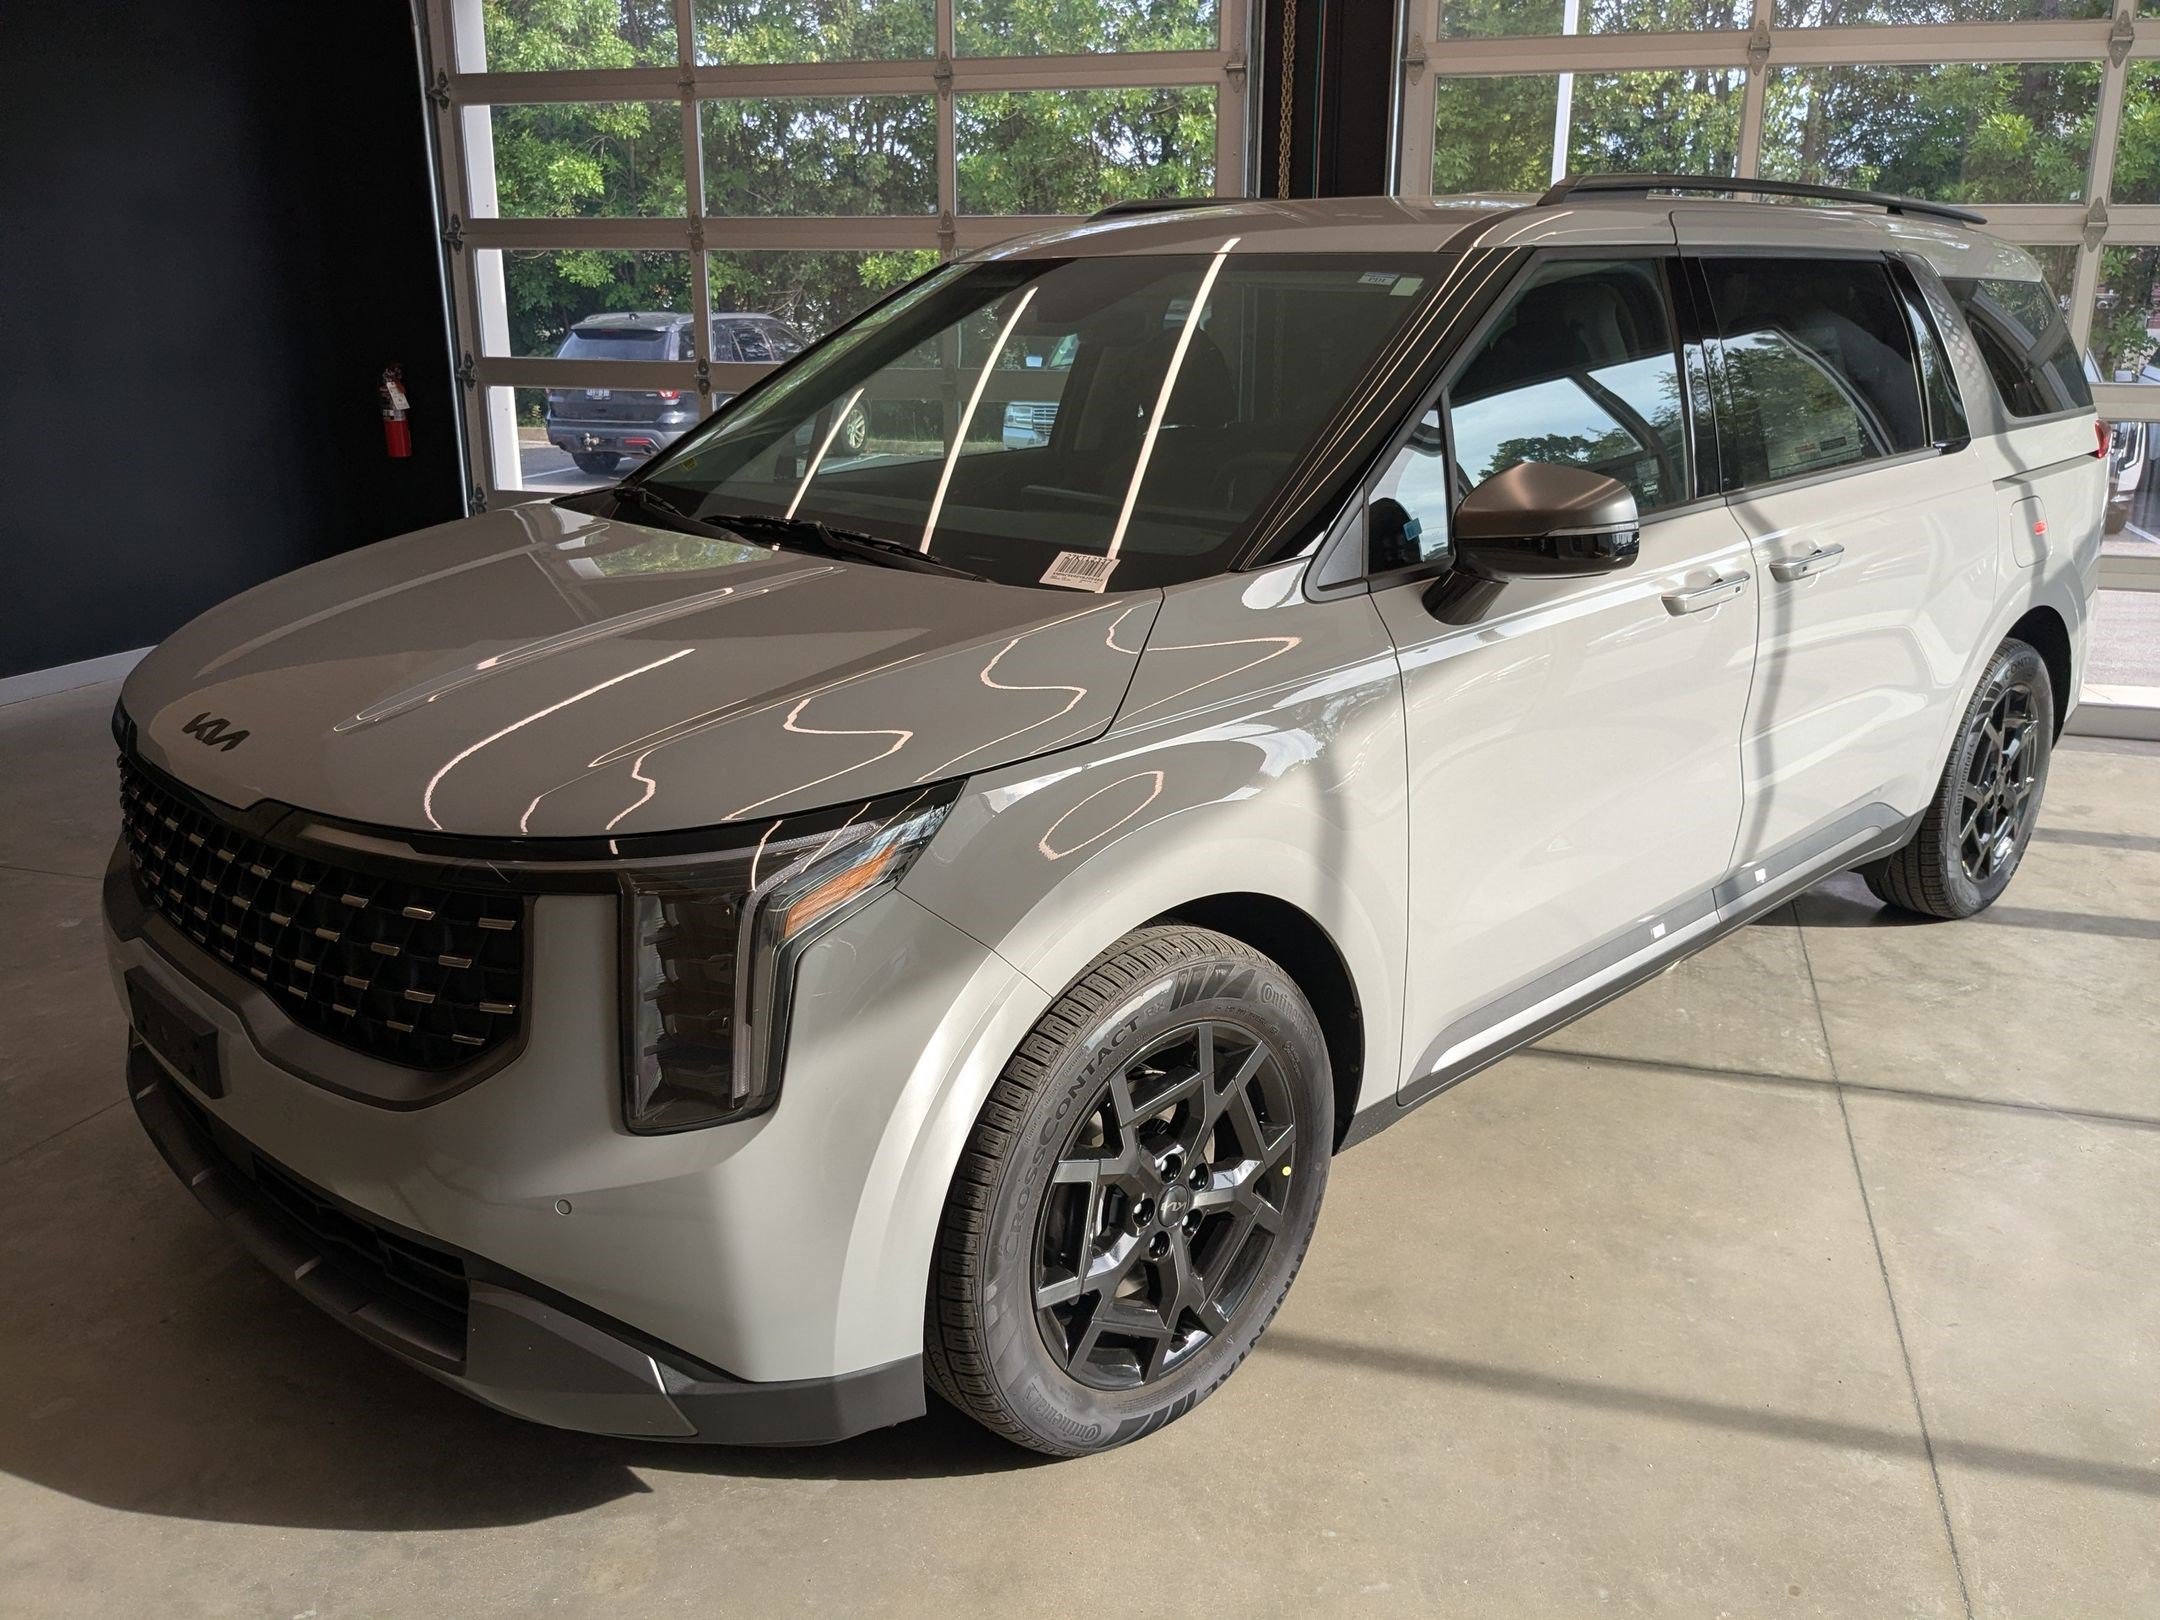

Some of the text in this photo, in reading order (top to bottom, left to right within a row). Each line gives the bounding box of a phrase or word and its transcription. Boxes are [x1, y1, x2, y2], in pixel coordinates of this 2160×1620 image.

[182, 711, 251, 752] KIA
[1260, 981, 1314, 1045] Continental
[1028, 1390, 1102, 1443] Continental
